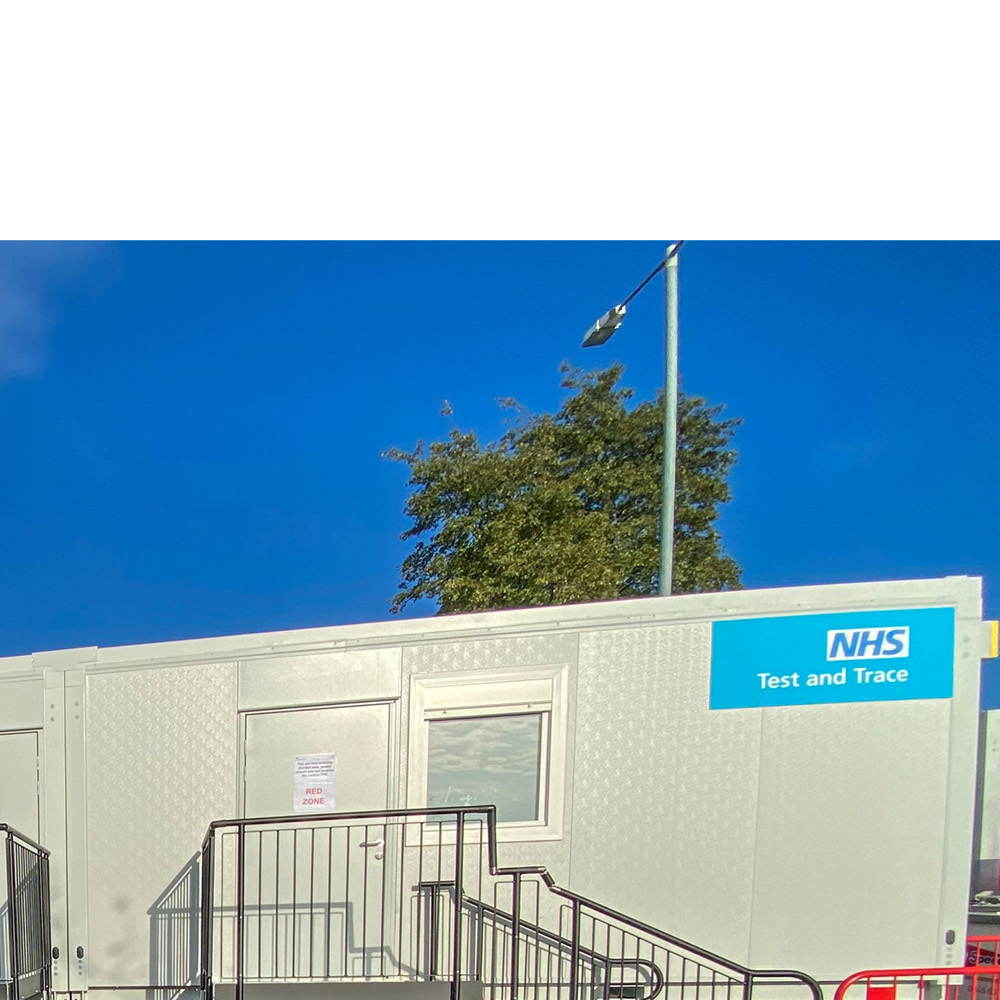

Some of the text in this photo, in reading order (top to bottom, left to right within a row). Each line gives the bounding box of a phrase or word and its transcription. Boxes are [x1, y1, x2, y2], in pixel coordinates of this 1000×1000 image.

[828, 628, 908, 659] NHS
[757, 667, 909, 689] Test and Trace
[302, 797, 325, 805] ZONE
